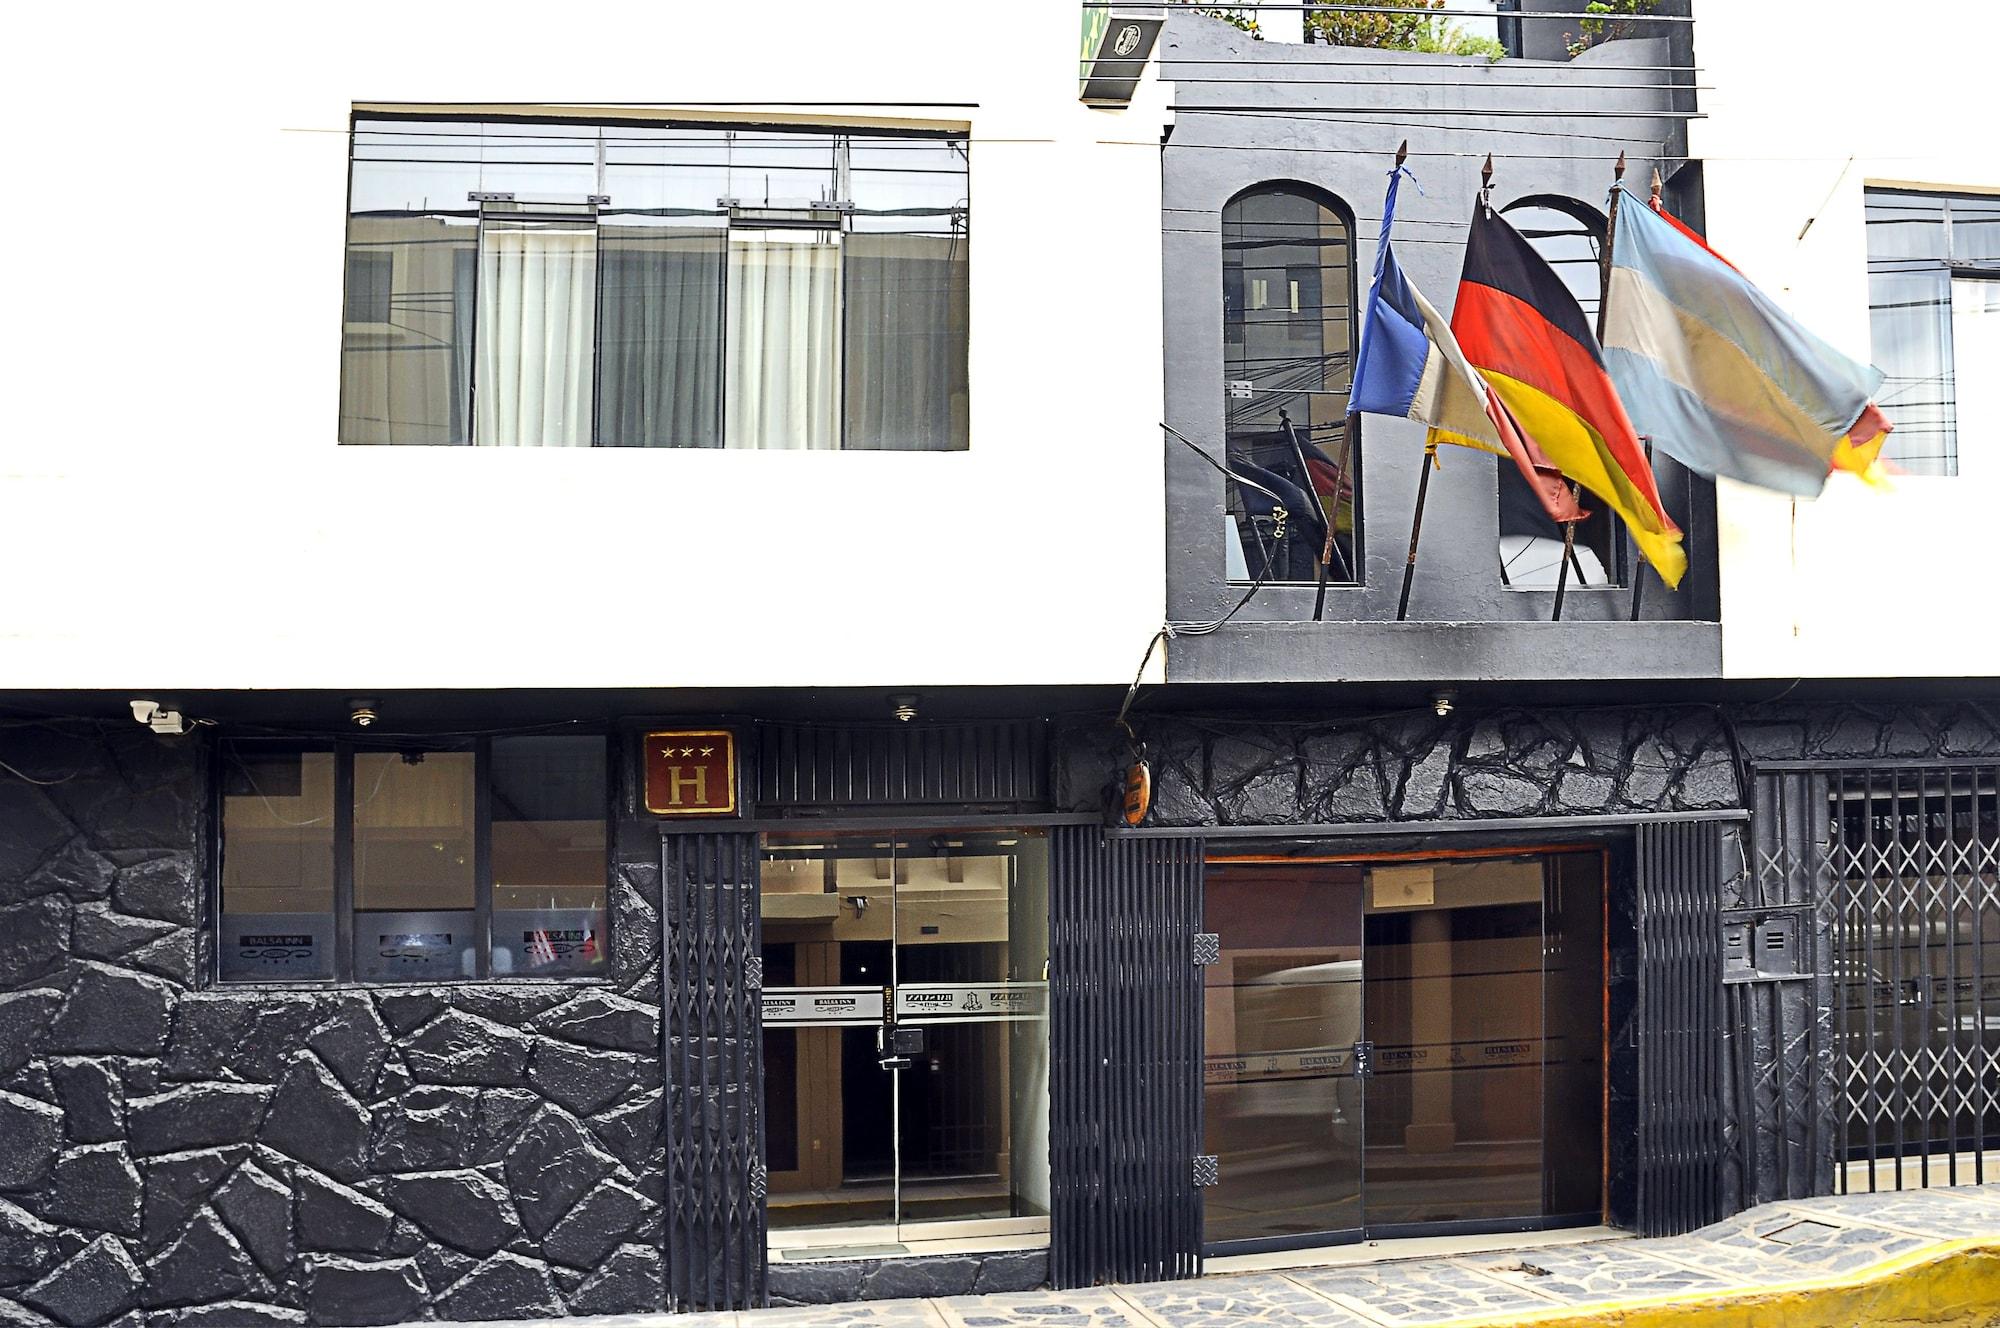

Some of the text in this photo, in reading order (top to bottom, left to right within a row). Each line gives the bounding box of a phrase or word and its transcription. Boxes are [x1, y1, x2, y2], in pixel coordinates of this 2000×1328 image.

[668, 765, 708, 805] H
[249, 937, 304, 945] BALSA INN
